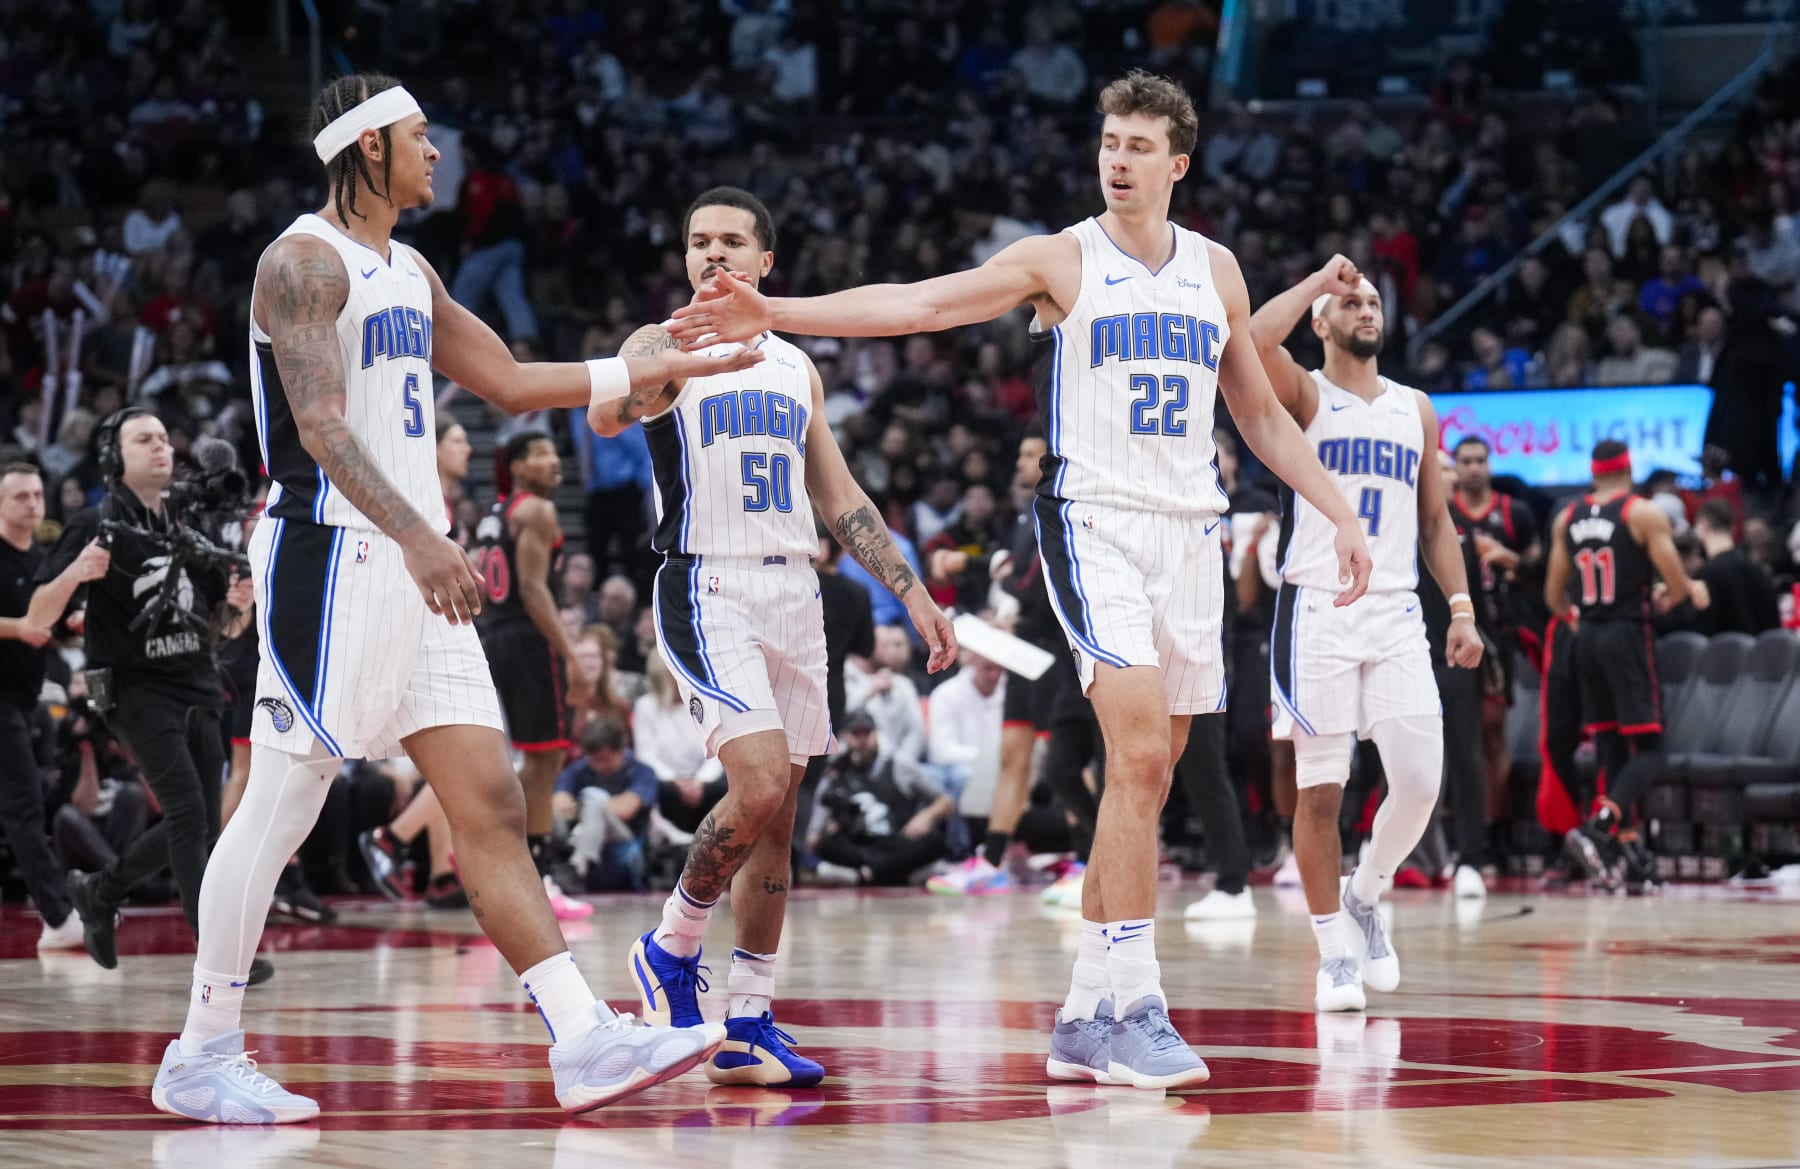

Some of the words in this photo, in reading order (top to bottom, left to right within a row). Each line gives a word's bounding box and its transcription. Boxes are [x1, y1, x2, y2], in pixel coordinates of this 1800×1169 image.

[1091, 312, 1220, 372] MAGIC
[403, 373, 425, 437] 5
[700, 390, 807, 459] MAGIC
[1130, 374, 1189, 437] 22
[741, 452, 793, 513] 50
[1318, 437, 1419, 490] MAGIC
[1358, 487, 1383, 537] 4
[1574, 547, 1615, 605] 11
